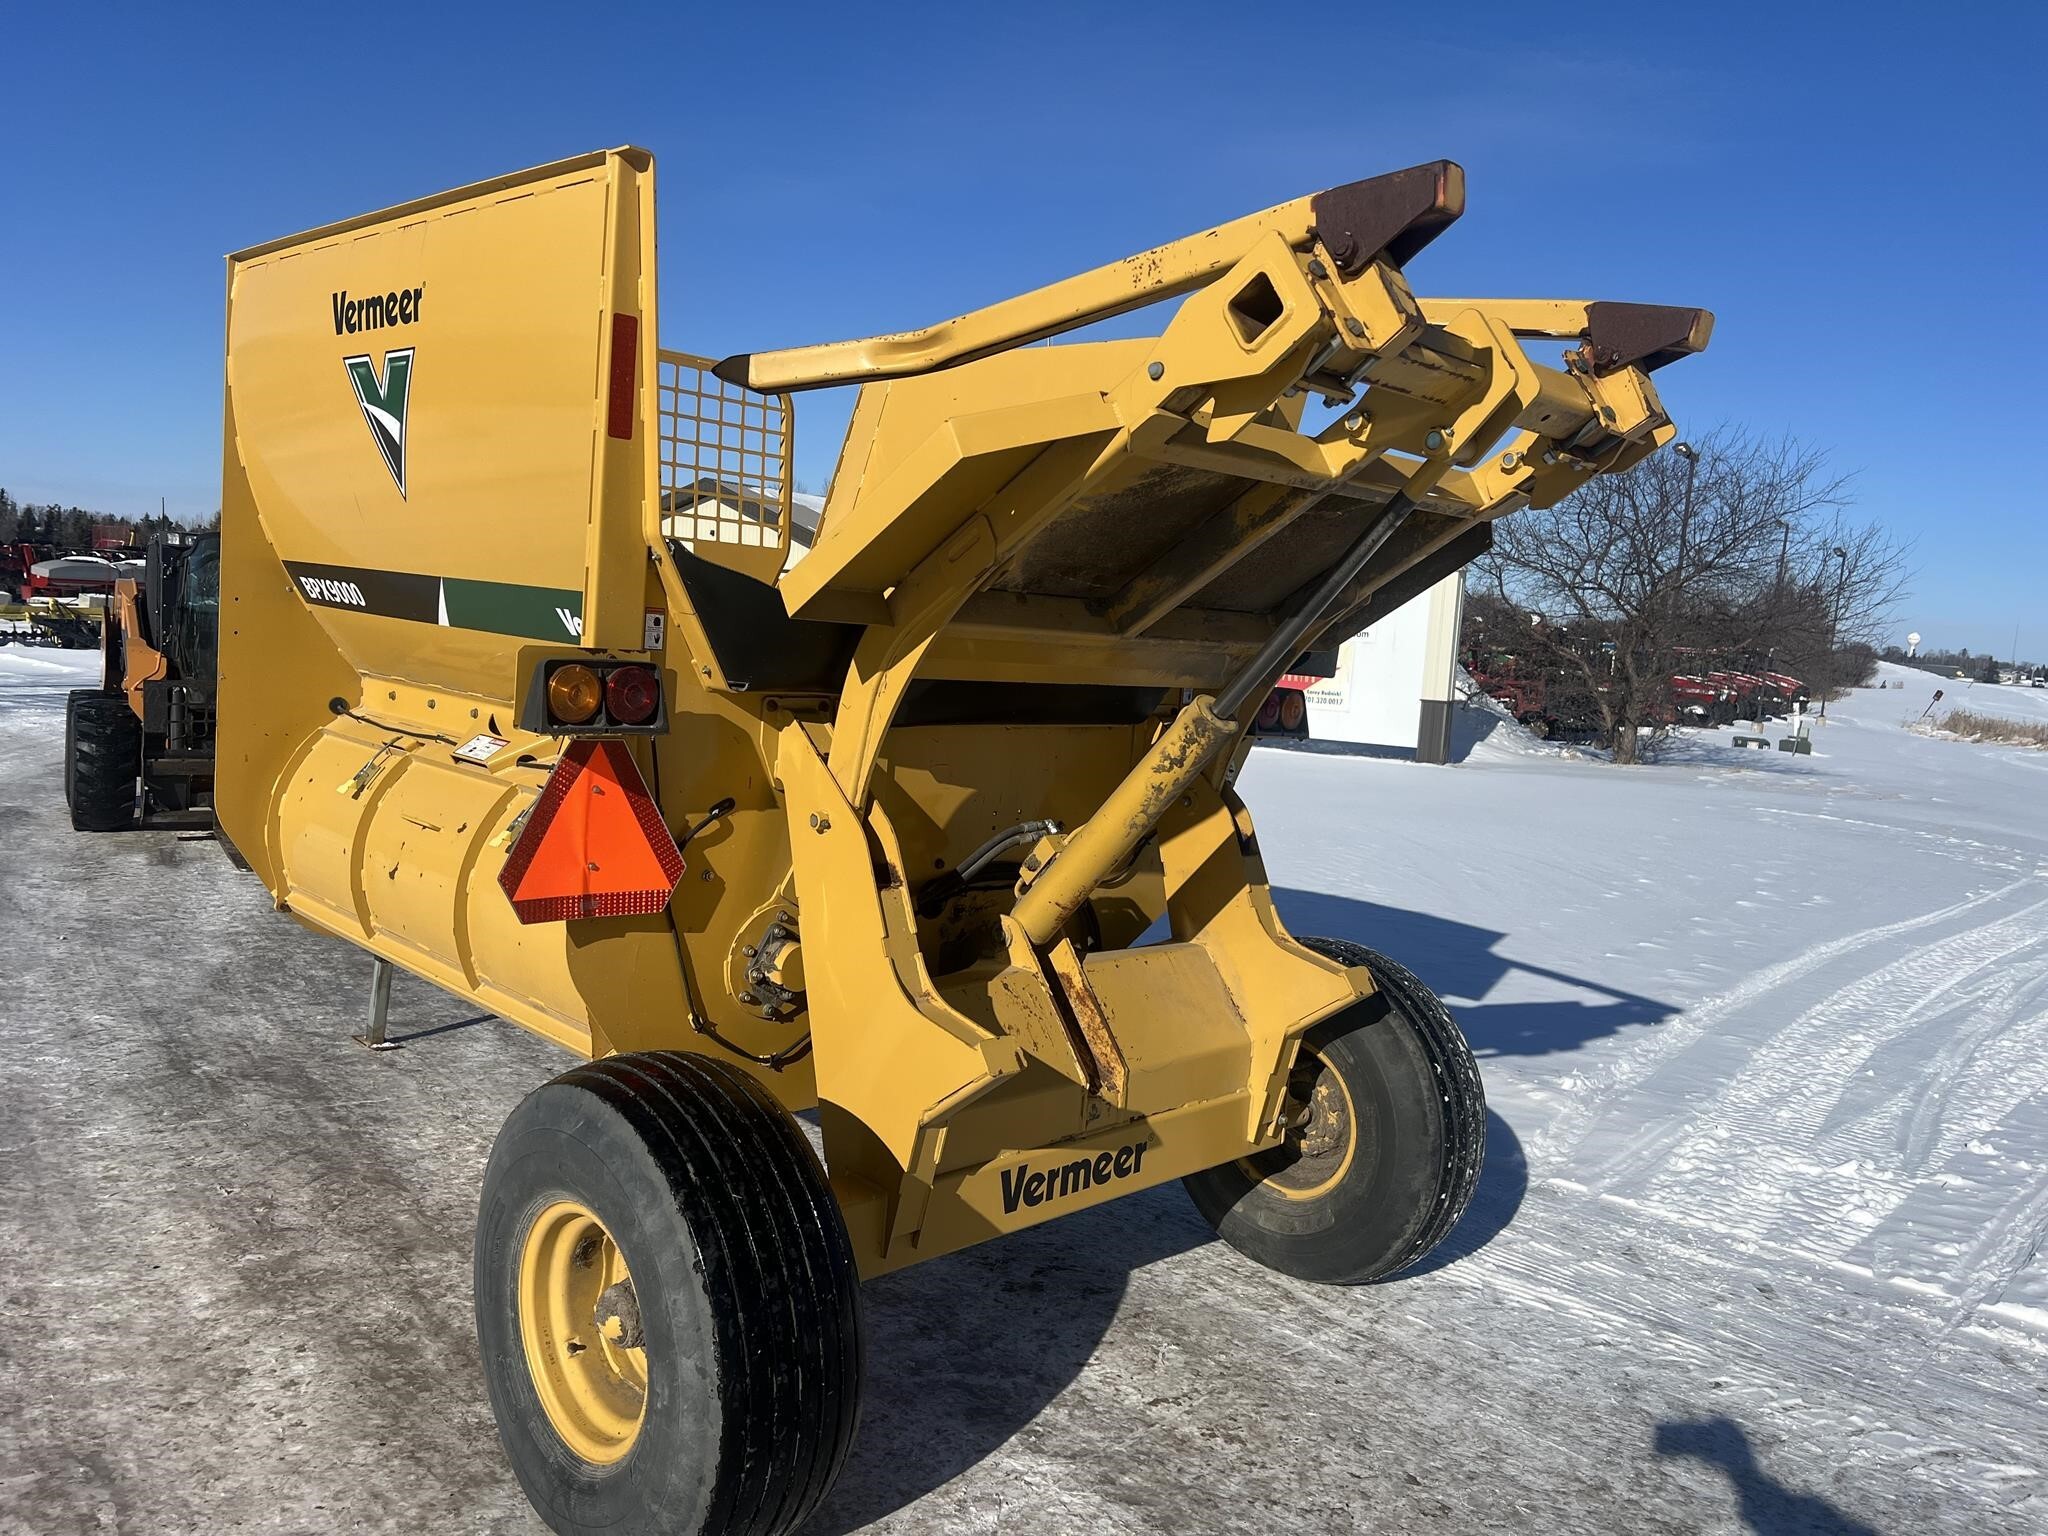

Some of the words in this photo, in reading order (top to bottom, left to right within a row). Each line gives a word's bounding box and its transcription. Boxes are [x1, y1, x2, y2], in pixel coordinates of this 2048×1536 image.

[332, 287, 423, 336] Vermeer
[299, 576, 366, 607] BPX9000
[1000, 1141, 1148, 1215] Vermeer
